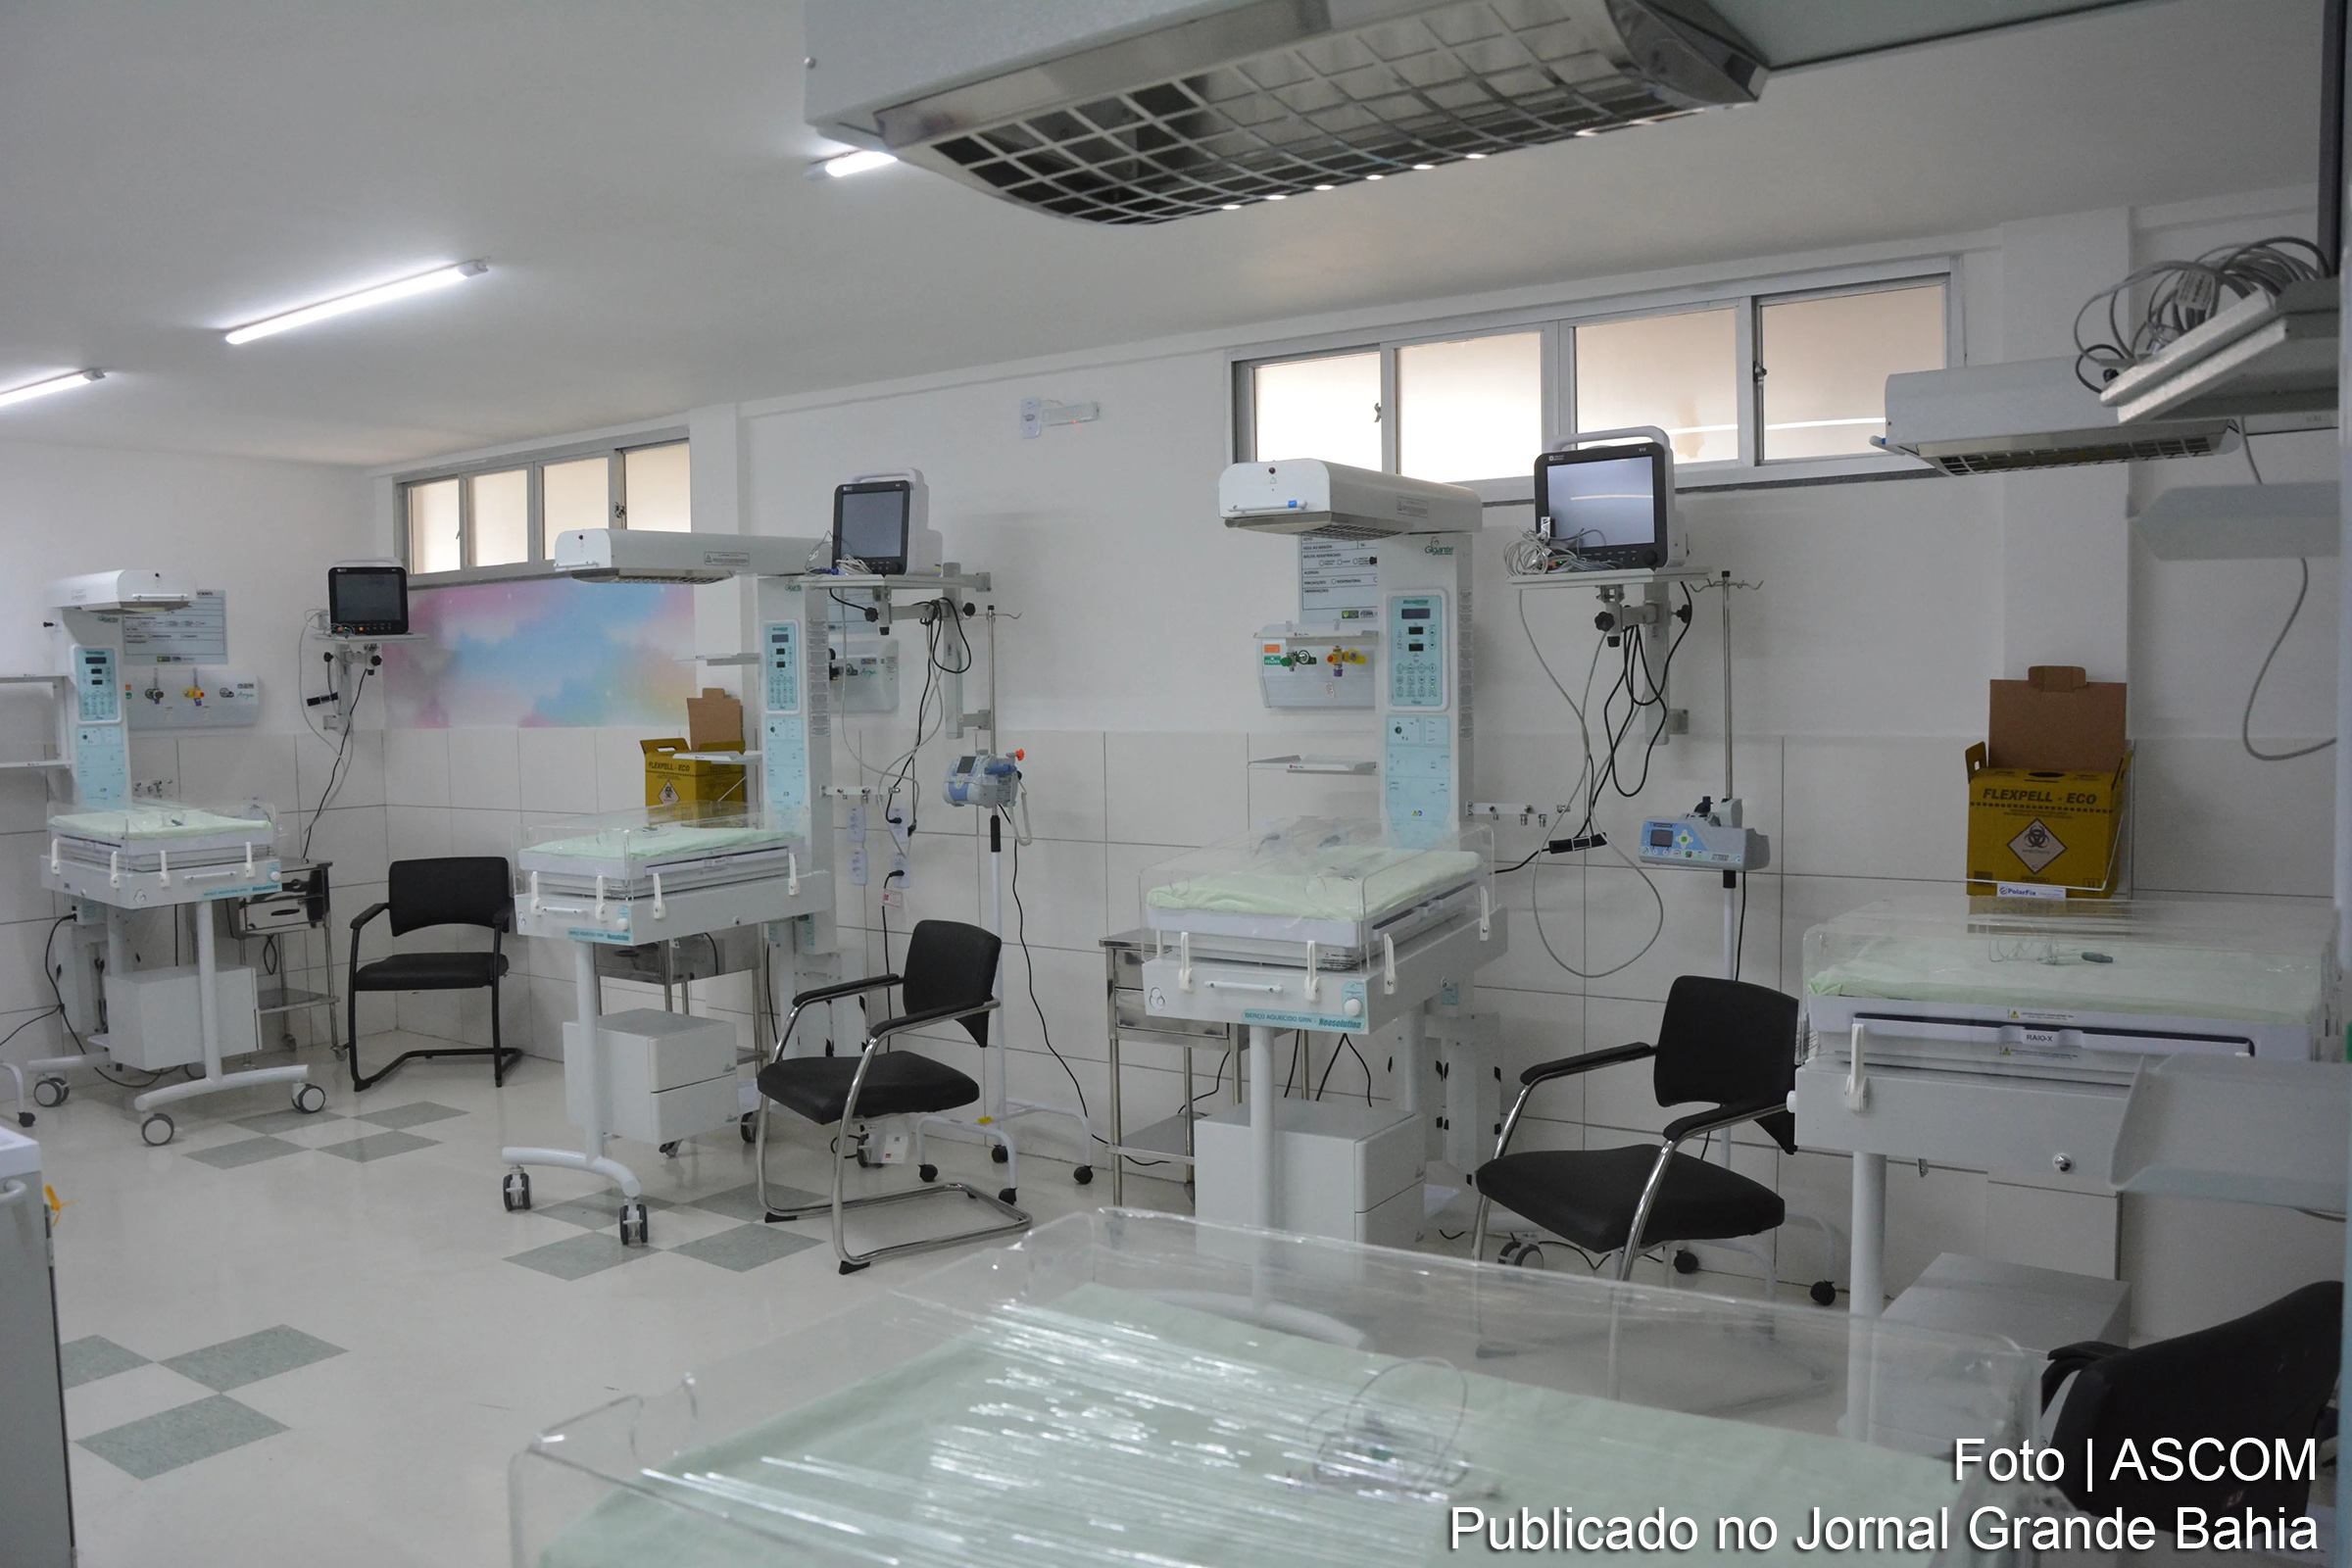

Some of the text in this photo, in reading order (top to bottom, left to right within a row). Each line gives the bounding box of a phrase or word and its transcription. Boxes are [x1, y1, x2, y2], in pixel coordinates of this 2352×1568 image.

[648, 760, 674, 771] FLEXPELL
[1983, 788, 2053, 803] FLEXPELL
[2066, 792, 2097, 806] ECO
[1245, 1011, 1266, 1020] BERÇO
[1266, 1013, 1298, 1022] AQUECIDO
[1318, 1017, 1362, 1029] Neosolution
